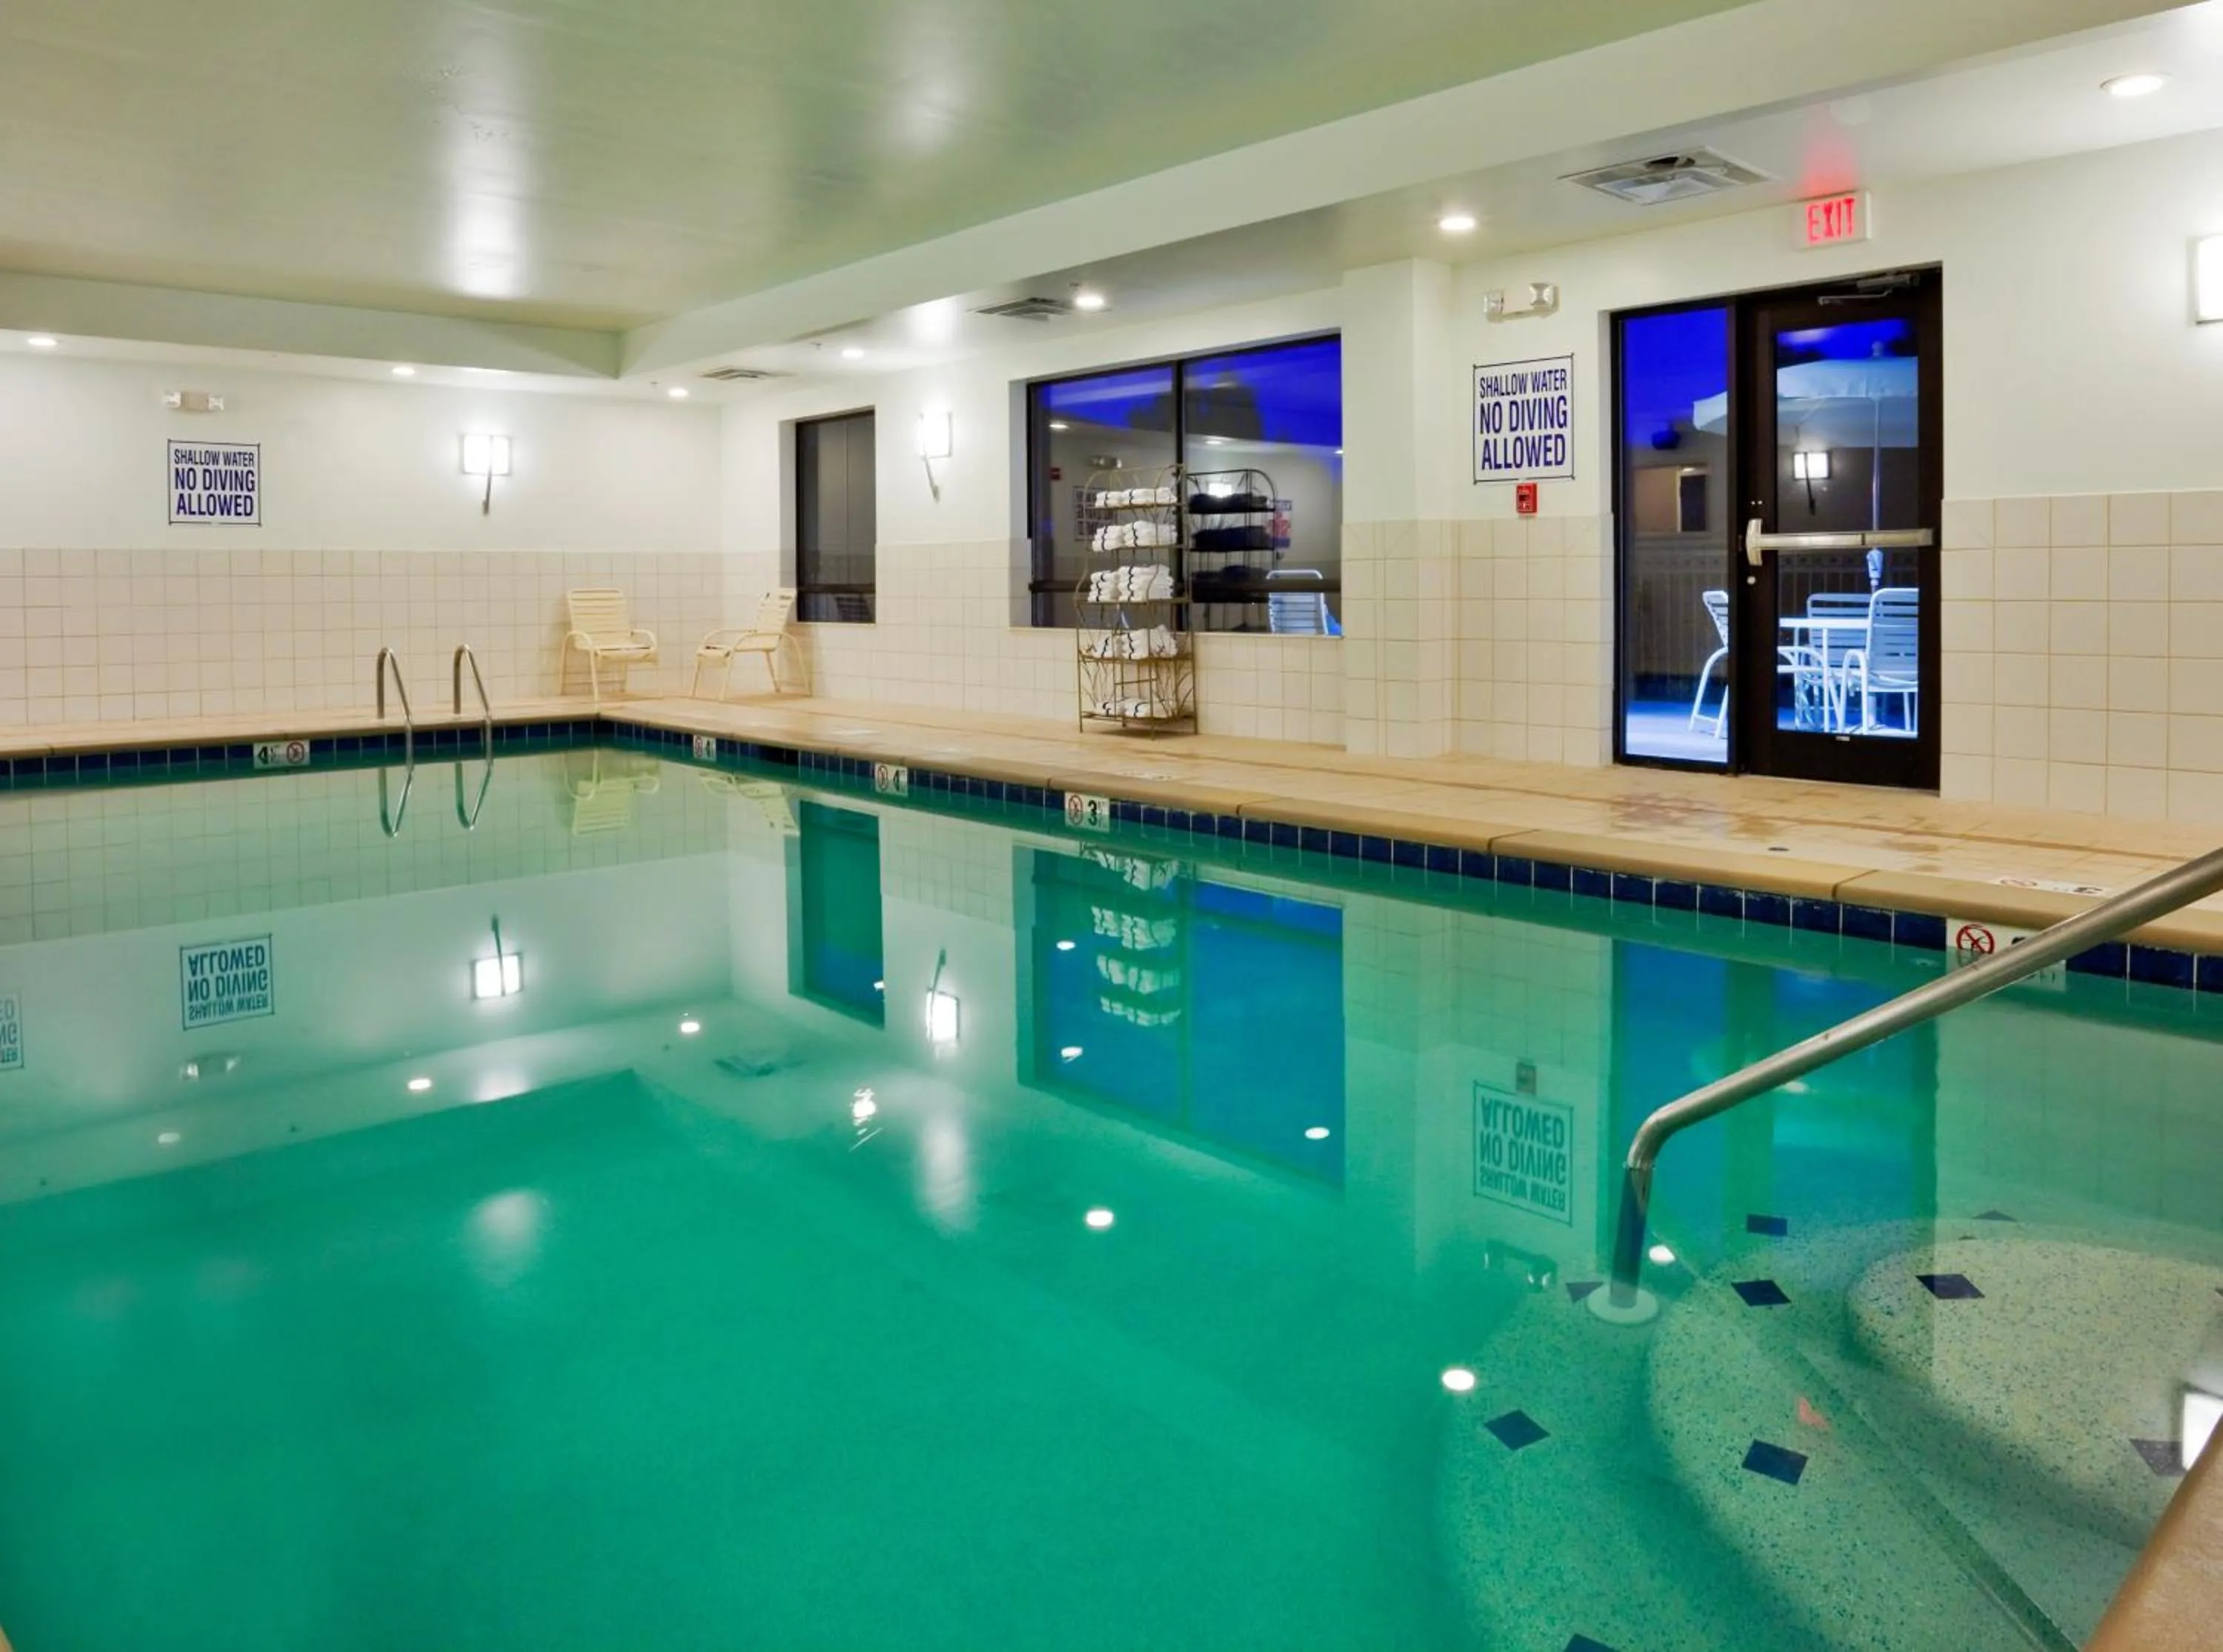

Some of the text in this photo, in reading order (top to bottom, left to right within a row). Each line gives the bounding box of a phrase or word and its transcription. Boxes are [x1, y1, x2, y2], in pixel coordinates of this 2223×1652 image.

[1806, 197, 1855, 242] EXIT
[1480, 369, 1567, 399] SHALLOW WATER
[1480, 395, 1567, 435] NO DIVING
[174, 448, 254, 467] SHALLOW WATER
[1482, 433, 1565, 470] ALLOWED
[175, 467, 255, 492] NO DIVING
[176, 493, 253, 516] ALLOWED
[258, 746, 268, 765] 4
[893, 770, 900, 793] 4
[1088, 799, 1097, 826] 3
